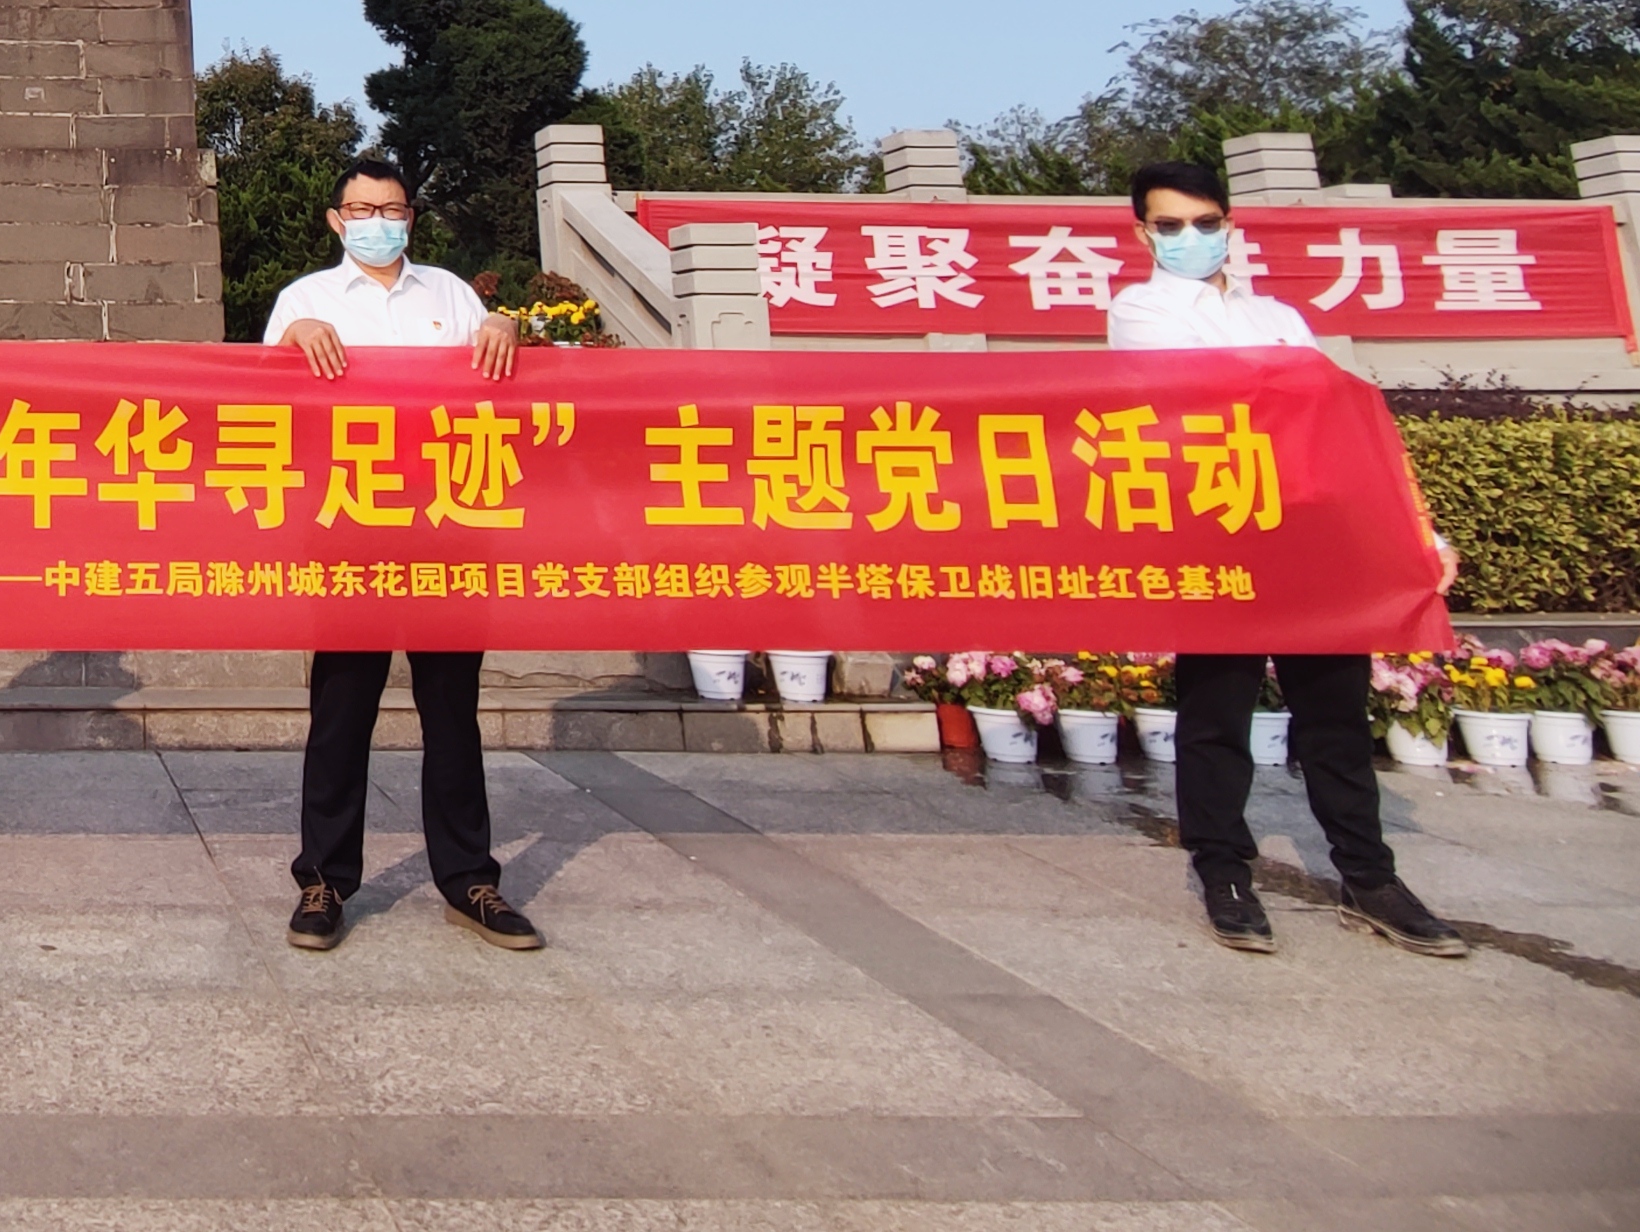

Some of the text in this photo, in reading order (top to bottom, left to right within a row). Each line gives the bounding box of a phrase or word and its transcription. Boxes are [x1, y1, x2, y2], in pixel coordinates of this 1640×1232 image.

[644, 401, 1283, 533] 主题党日活动
